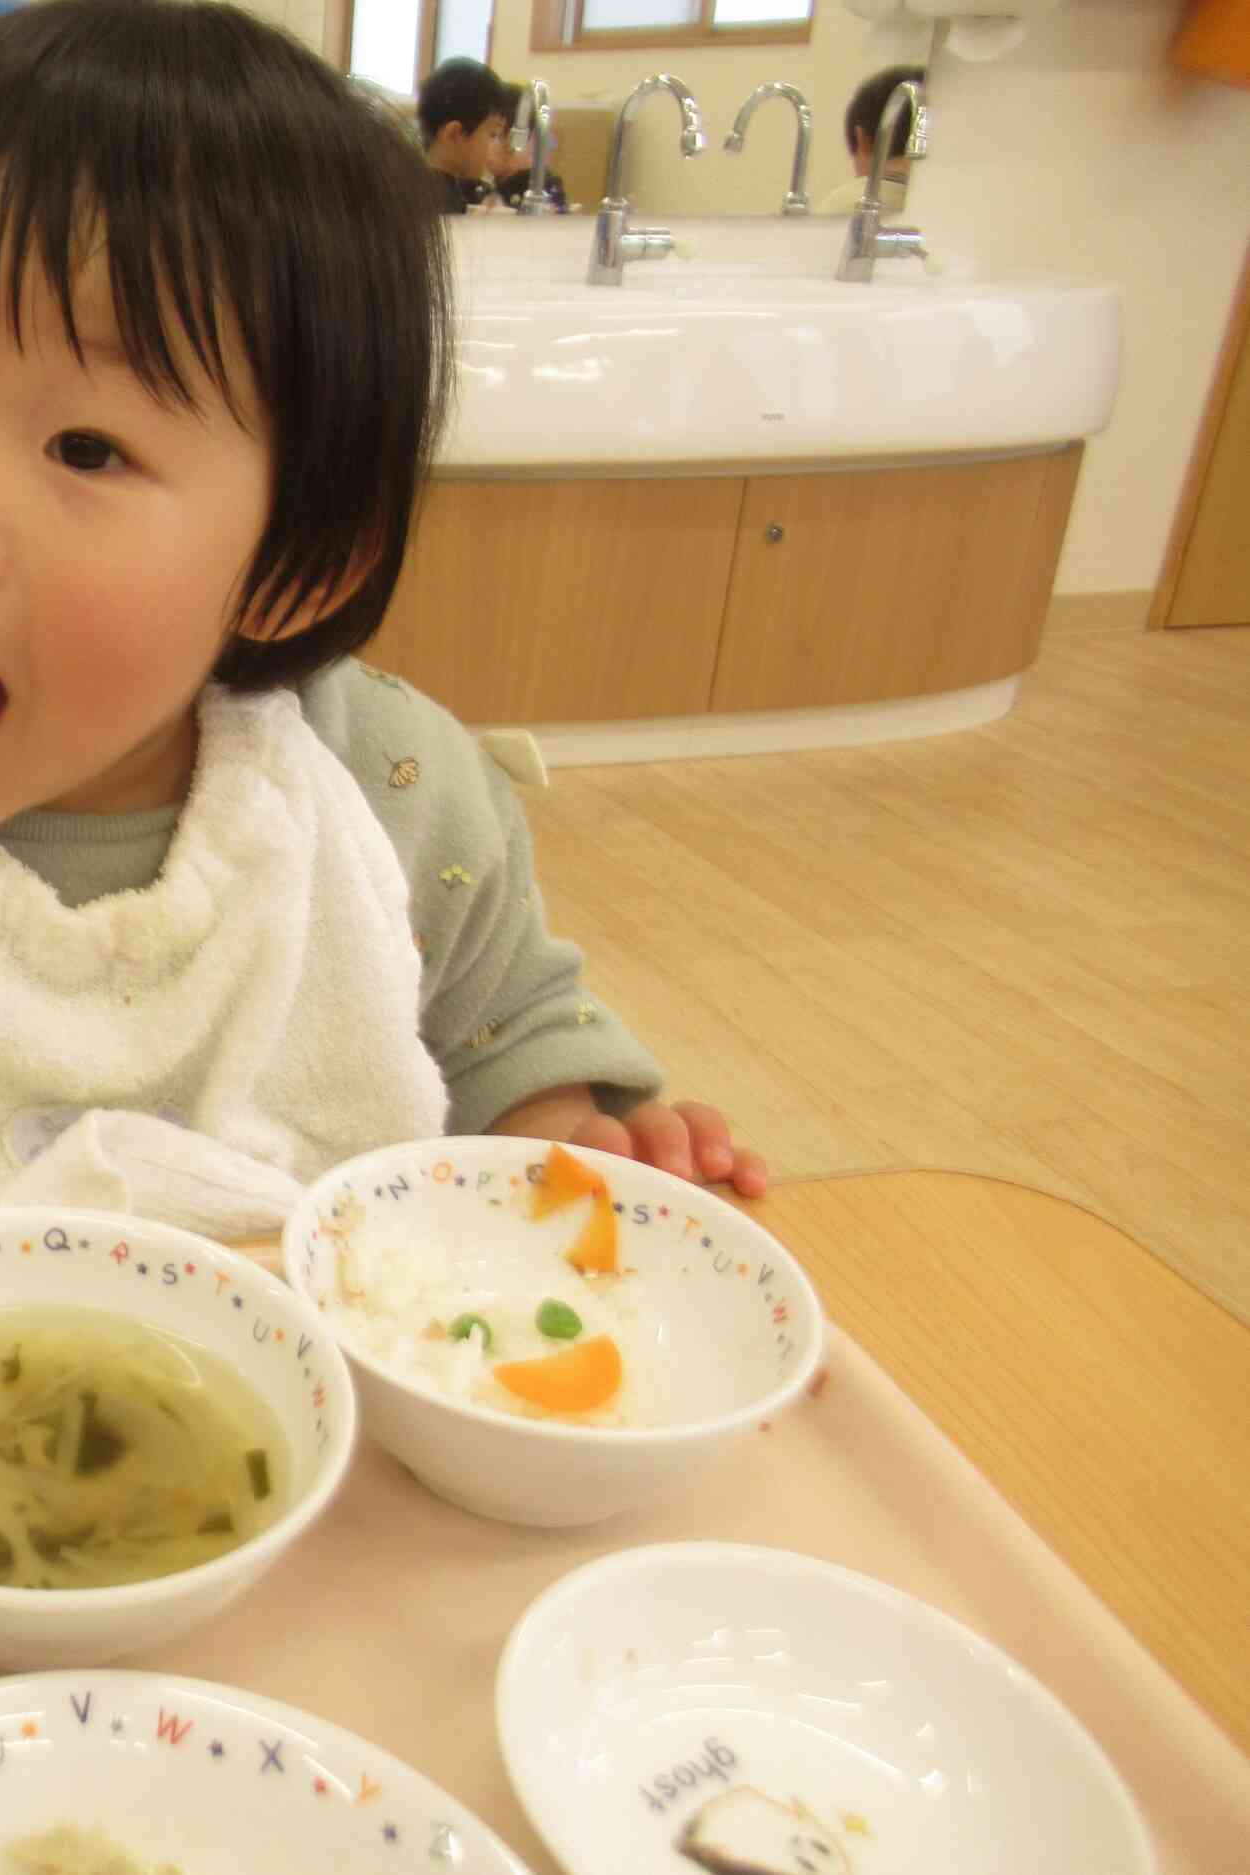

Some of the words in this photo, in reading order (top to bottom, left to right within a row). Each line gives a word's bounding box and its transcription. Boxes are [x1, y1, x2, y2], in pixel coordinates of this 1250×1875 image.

[432, 1161, 452, 1184] O
[632, 1204, 650, 1225] S
[712, 1250, 732, 1273] U
[44, 1227, 71, 1252] Q
[162, 1263, 179, 1286] S
[252, 1316, 271, 1343] U
[69, 1690, 92, 1725] V
[155, 1705, 194, 1745] W
[258, 1738, 285, 1774] X
[641, 1738, 737, 1812] ghost
